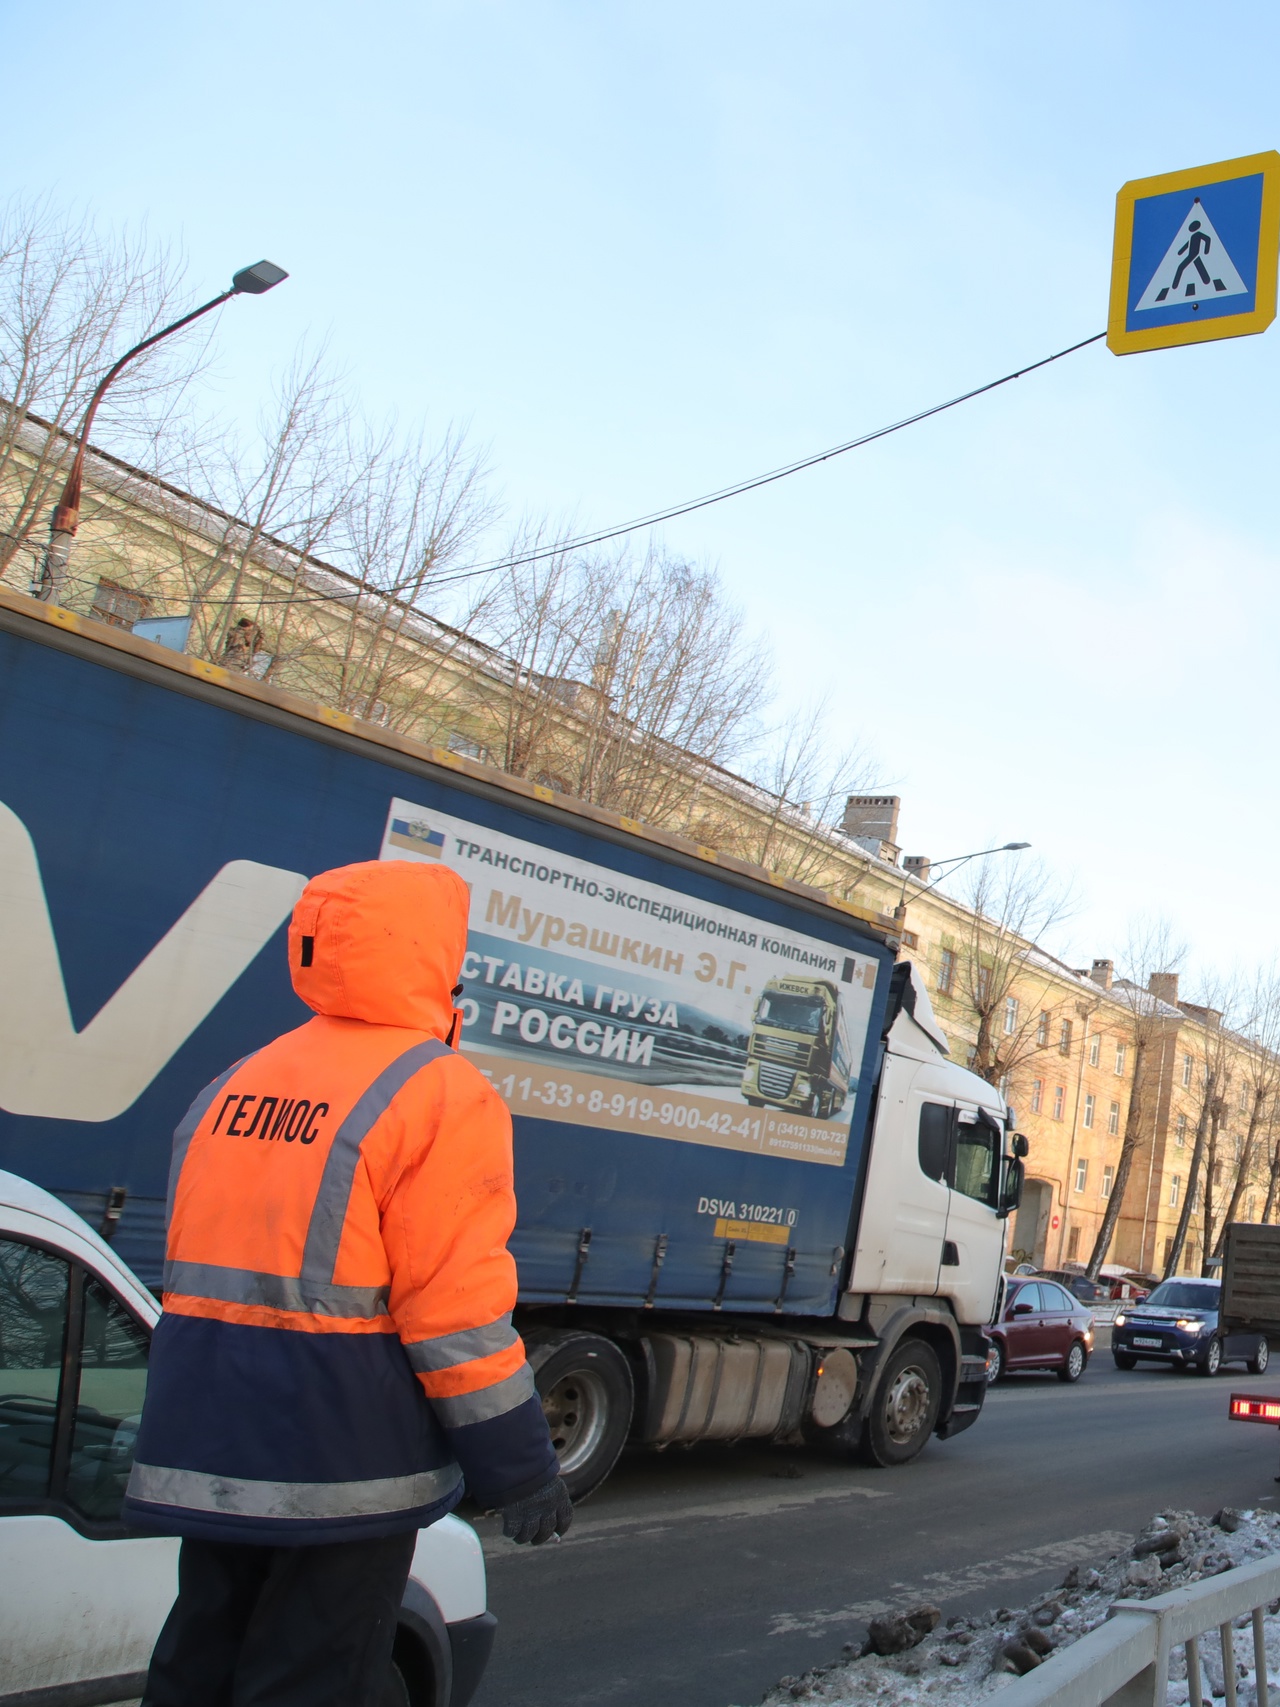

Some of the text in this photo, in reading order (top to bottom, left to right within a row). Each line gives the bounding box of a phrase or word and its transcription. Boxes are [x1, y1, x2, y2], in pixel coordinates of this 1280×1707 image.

[455, 838, 836, 973] ТРАНСПОРТНО-ЭКСПЕДИЦИОННАЯ КОМПАНИЯ
[484, 889, 752, 995] Мурашкин Э.Г.
[593, 984, 679, 1028] ГРУЗА
[779, 982, 810, 995] ИЖЕВСК
[491, 1000, 656, 1066] РОССИИ
[211, 1094, 329, 1145] ГЕЛИОС
[768, 1120, 847, 1144] 8 (3412) 970-723
[697, 1196, 796, 1225] DSVA 310221 0
